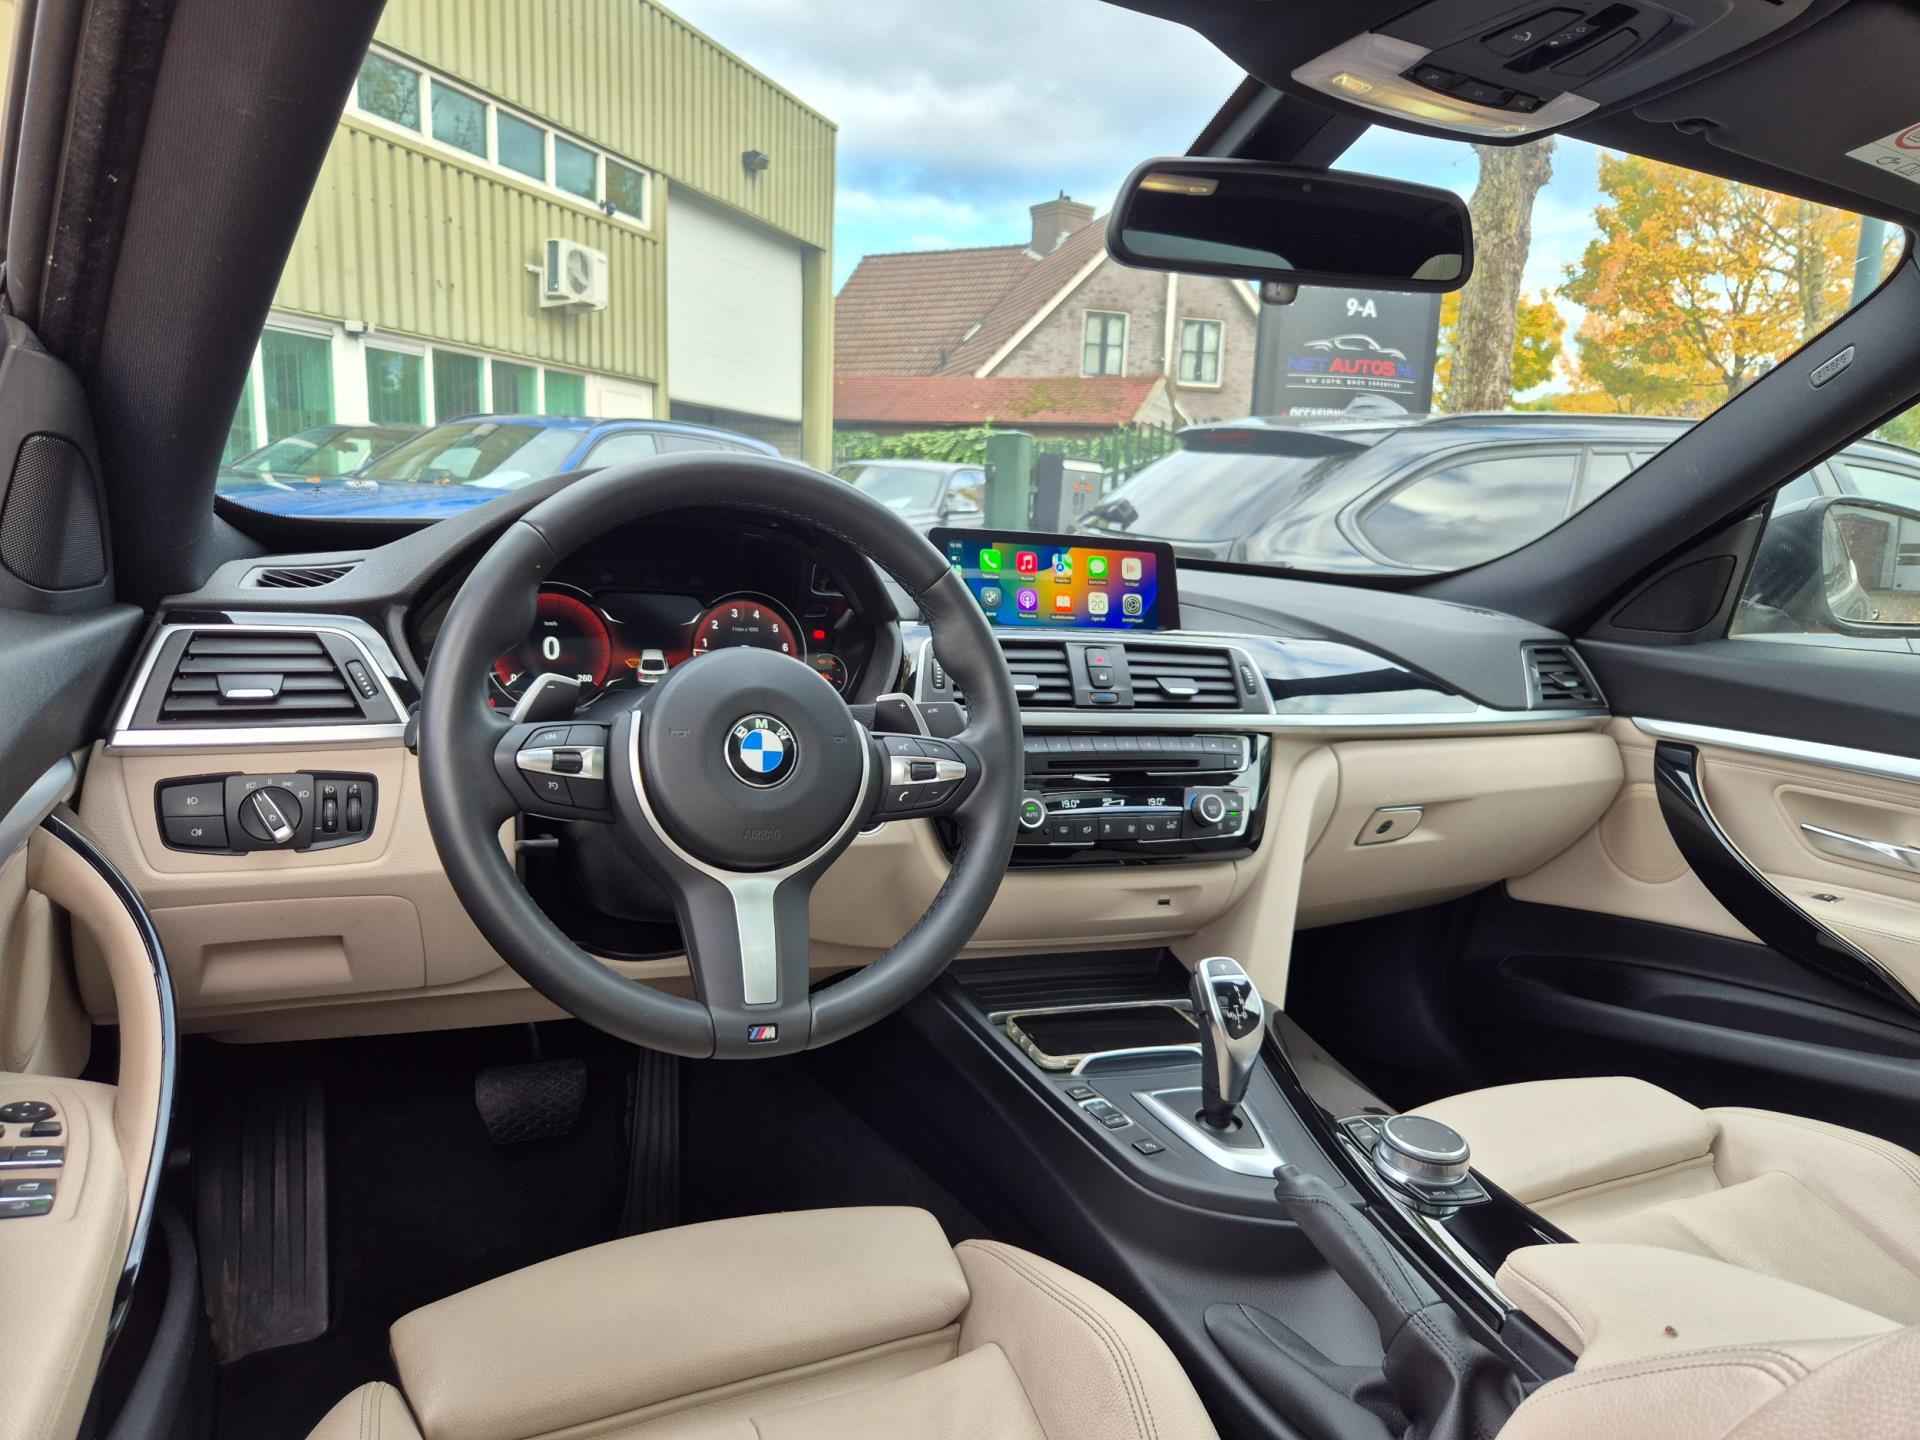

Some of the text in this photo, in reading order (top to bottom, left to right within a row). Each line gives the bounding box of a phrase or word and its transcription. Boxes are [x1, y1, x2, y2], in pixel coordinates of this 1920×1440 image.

[1346, 298, 1377, 318] 9-A
[1817, 354, 1847, 380] AIRBAG
[1091, 600, 1105, 611] 20
[731, 608, 739, 618] 3
[752, 609, 760, 619] 4
[711, 620, 719, 630] 2
[772, 623, 779, 633] 5
[702, 638, 708, 648] 1
[782, 642, 789, 652] 6
[543, 636, 560, 661] 0
[734, 719, 790, 740] BMW
[743, 829, 781, 841] AIRBAG
